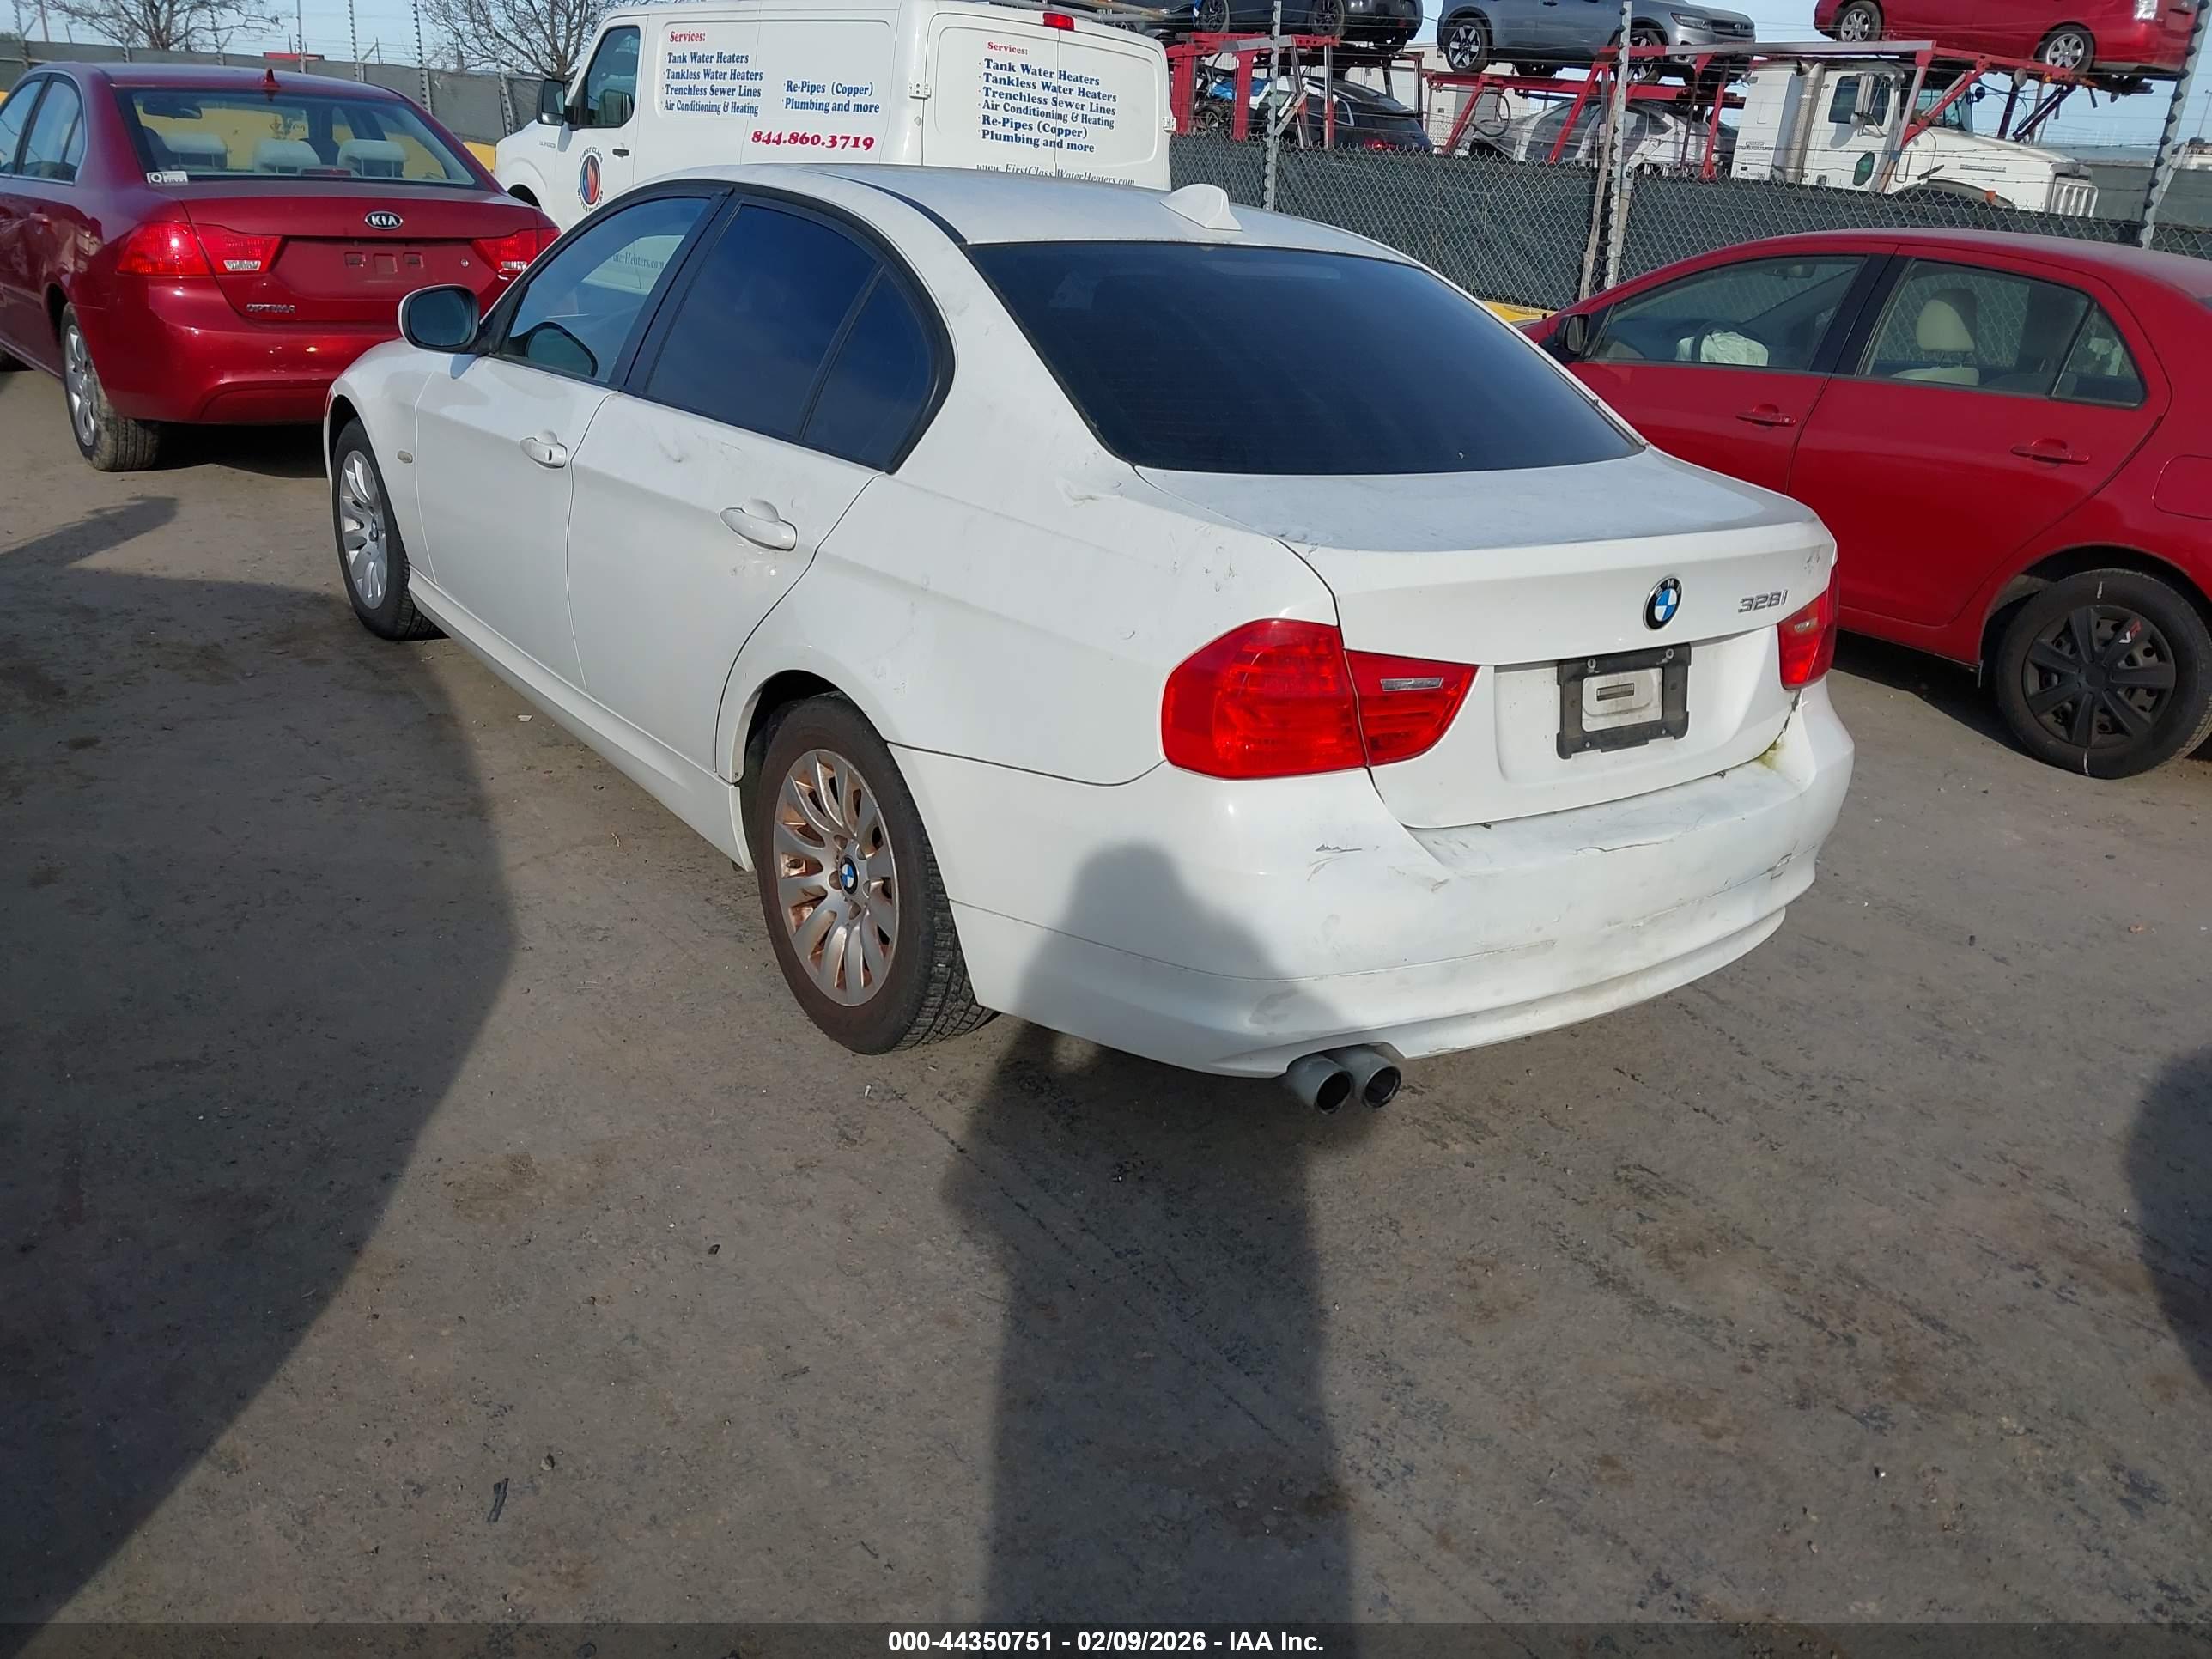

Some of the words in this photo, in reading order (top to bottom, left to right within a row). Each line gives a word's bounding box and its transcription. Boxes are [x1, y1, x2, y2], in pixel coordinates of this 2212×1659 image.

[670, 31, 706, 42] Services:
[988, 41, 1028, 55] Services:
[667, 52, 687, 64] Tank
[690, 52, 714, 64] Water
[716, 52, 749, 64] Heaters
[666, 68, 701, 80] Tankless
[702, 68, 727, 81] Water
[729, 69, 763, 81] Heaters
[984, 58, 1016, 73] Tank
[1020, 64, 1054, 79] Water
[1058, 70, 1100, 86] Heaters
[665, 84, 708, 96] Trenchless
[708, 84, 736, 97] Sewer
[738, 85, 762, 97] Lines
[786, 80, 826, 95] Re-Pipes
[831, 81, 873, 97] (Copper)
[983, 72, 1036, 90] Tankless
[1041, 81, 1074, 95] Water
[1077, 86, 1117, 102] Heaters
[664, 100, 675, 110] Air
[722, 100, 730, 112] &
[731, 101, 759, 117] Heating
[785, 97, 830, 114] Plumbing
[831, 100, 850, 112] and
[853, 104, 880, 113] more
[982, 87, 1048, 105] Trenchless
[1051, 96, 1086, 111] Sewer
[1089, 102, 1116, 116] Lines
[982, 100, 1000, 111] Air
[1003, 102, 1068, 124] Conditioning
[1071, 112, 1079, 122] &
[1081, 114, 1115, 130] Heating
[981, 114, 1034, 131] Re-Pipes
[1037, 121, 1088, 139] (Copper)
[751, 130, 874, 151] 844.860.3719
[981, 129, 1040, 149] Plumbing
[1042, 138, 1064, 149] and
[1066, 142, 1095, 152] more
[371, 215, 398, 226] KIA
